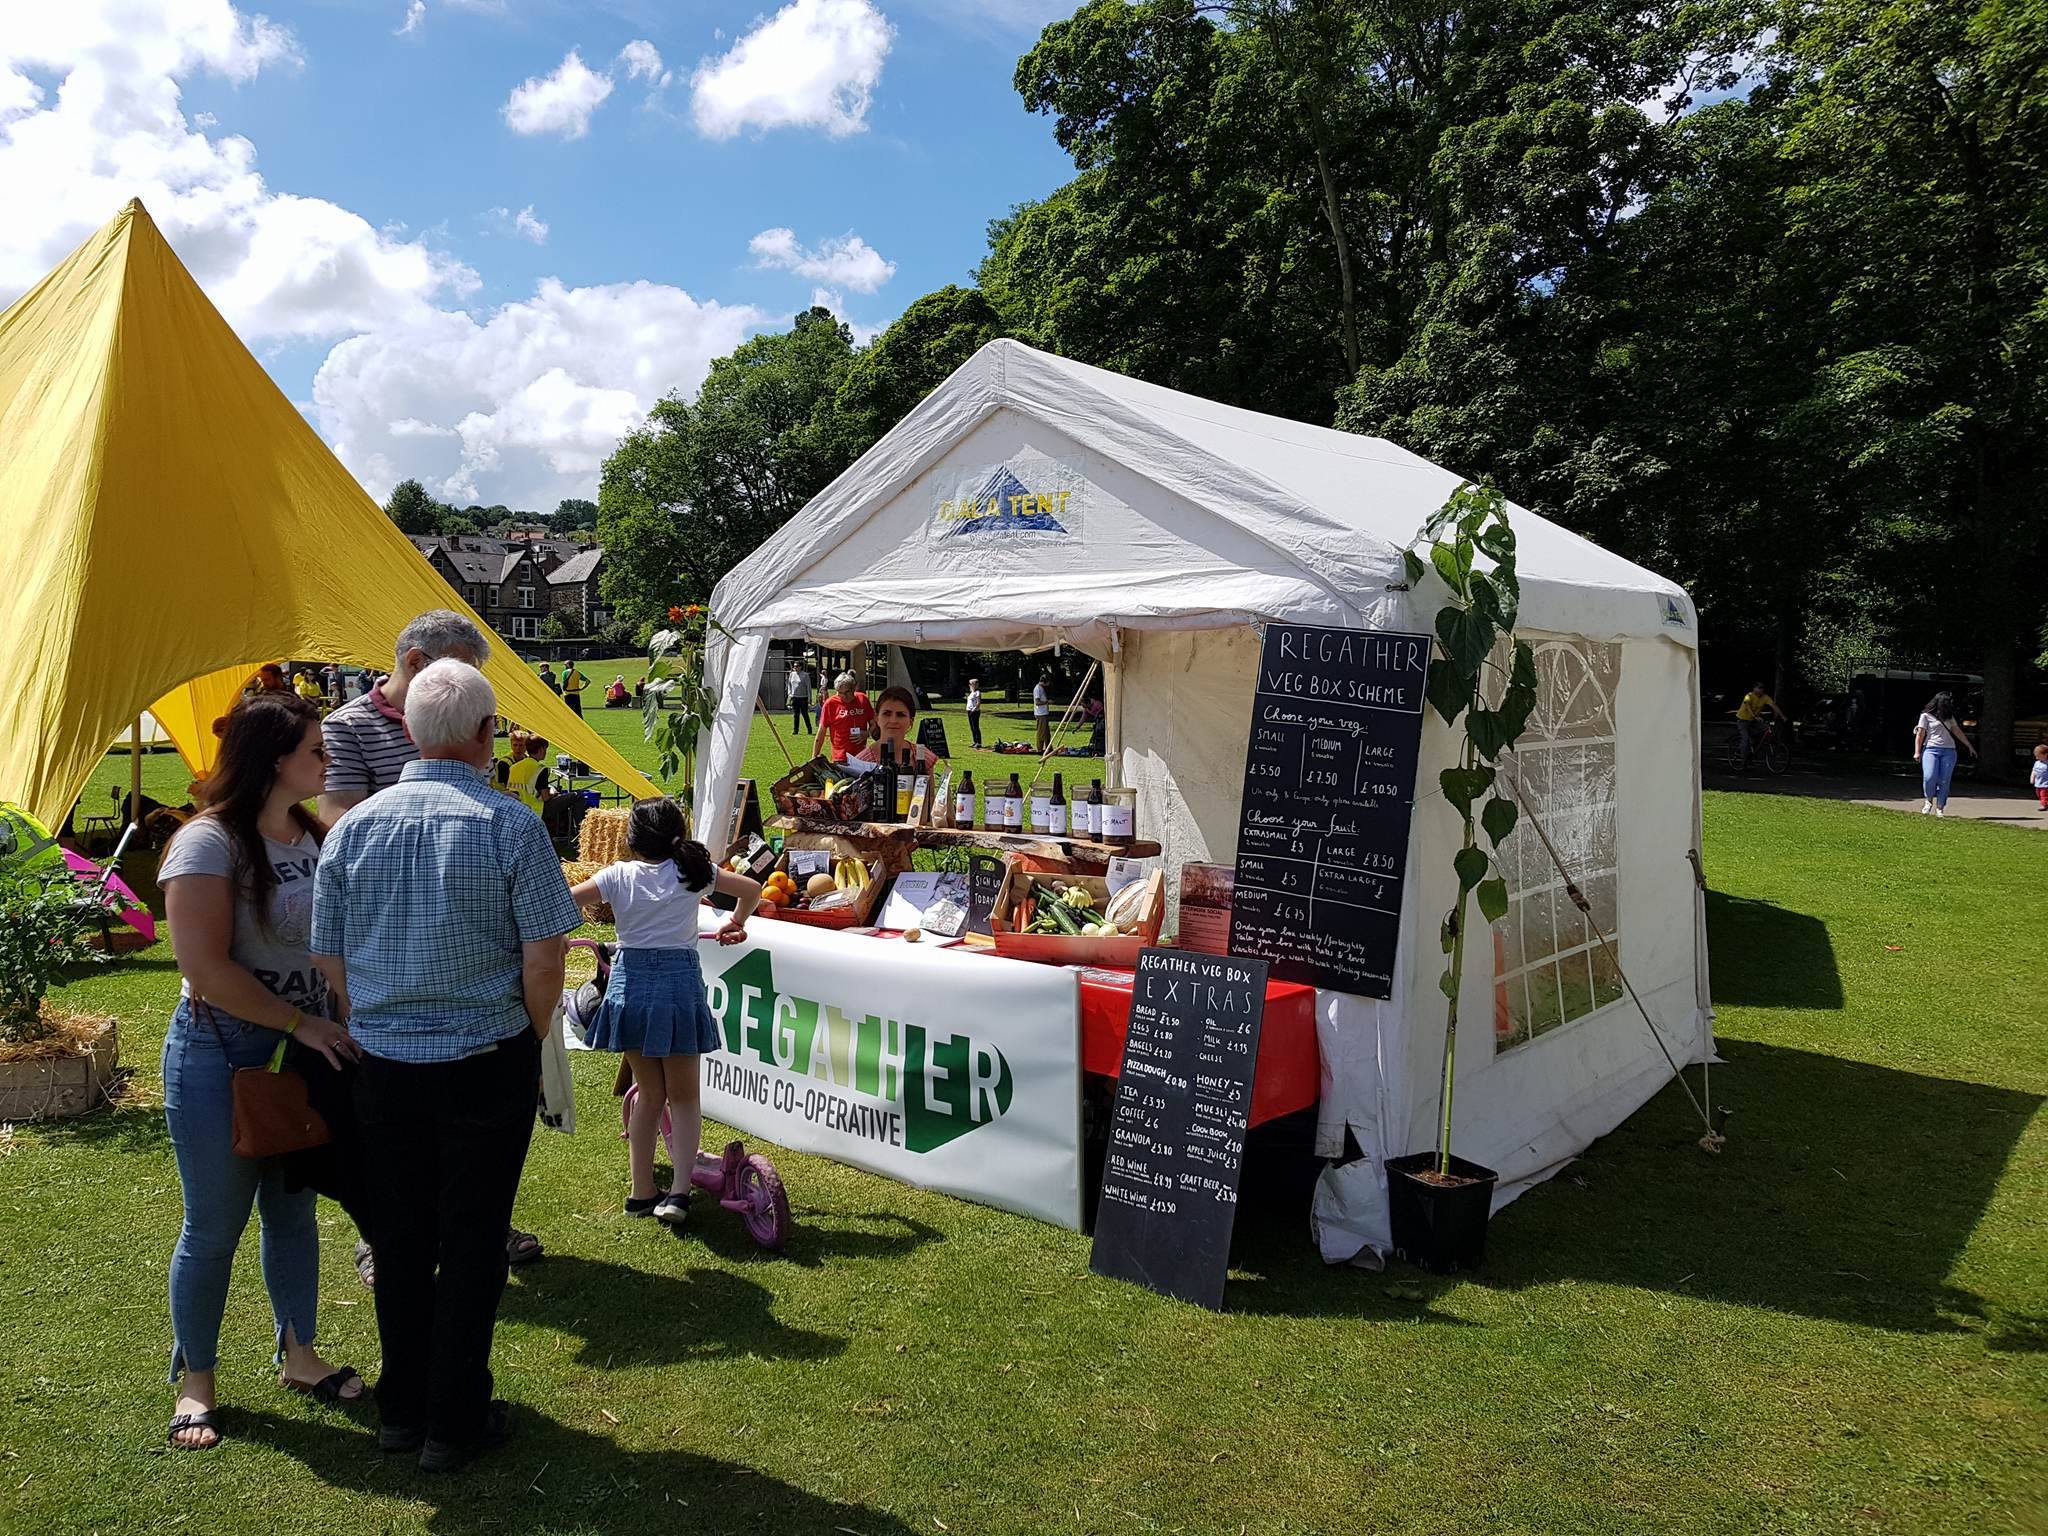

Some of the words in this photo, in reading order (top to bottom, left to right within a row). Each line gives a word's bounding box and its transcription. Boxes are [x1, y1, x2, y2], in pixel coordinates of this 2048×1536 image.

[1008, 490, 1072, 516] TENT
[1280, 631, 1424, 672] REGATHER
[1267, 670, 1302, 692] VEG
[1310, 675, 1342, 696] BOX
[1349, 680, 1406, 705] SCHEME
[1263, 705, 1304, 722] Choose
[1307, 715, 1335, 731] your
[1257, 728, 1285, 743] SMALL
[1311, 738, 1342, 752] MEDIUM
[1365, 745, 1395, 758] LARGE
[1110, 817, 1129, 826] MALT
[1247, 809, 1284, 824] Choose
[1291, 817, 1317, 837] your
[1290, 840, 1304, 852] £3
[1327, 846, 1355, 857] LARGE
[1363, 852, 1394, 870] £8.50
[272, 857, 318, 885] EV
[975, 874, 991, 887] SIGN
[992, 879, 1001, 889] UP
[1240, 858, 1264, 870] SMALL
[1281, 871, 1297, 886] £5
[1319, 869, 1345, 881] EXTRA
[1348, 874, 1377, 886] LARGE
[1374, 885, 1384, 899] £
[1235, 890, 1268, 901] MEDIUM
[1274, 902, 1305, 921] £6.75
[1140, 955, 1197, 974] REGATHER
[1201, 964, 1222, 977] VEG
[1226, 967, 1251, 984] BOX
[1146, 976, 1252, 1014] EXTRAS
[1135, 1004, 1157, 1016] BREAD
[1133, 1022, 1149, 1033] EGGS
[1205, 1018, 1217, 1026] OIL
[1237, 1022, 1251, 1034] £6
[706, 976, 1004, 1124] REGATHER
[1129, 1039, 1152, 1053] BAGELS
[1203, 1034, 1221, 1045] MILK
[1126, 1058, 1144, 1072] PIZZA
[1144, 1064, 1167, 1078] DOUGH
[1199, 1052, 1223, 1064] CHEESE
[1123, 1085, 1139, 1097] TEA
[1196, 1073, 1230, 1089] HONEY
[1228, 1089, 1241, 1101] £5
[705, 1056, 769, 1106] TRADING
[773, 1077, 902, 1148] CO-OPERATIVE
[1120, 1105, 1146, 1120] COFFEE
[1144, 1117, 1159, 1129] £6
[1115, 1128, 1151, 1145] GRANOLA
[1224, 1138, 1242, 1153] £10
[1111, 1154, 1125, 1167] RED
[1127, 1160, 1148, 1173] WINE
[1186, 1144, 1205, 1155] APPLE
[1207, 1148, 1227, 1160] JUICE
[1224, 1157, 1237, 1169] £3
[1180, 1173, 1202, 1187] CRAFT
[1203, 1178, 1220, 1190] BEER
[1104, 1184, 1128, 1200] WHITE
[1129, 1191, 1148, 1204] WINE
